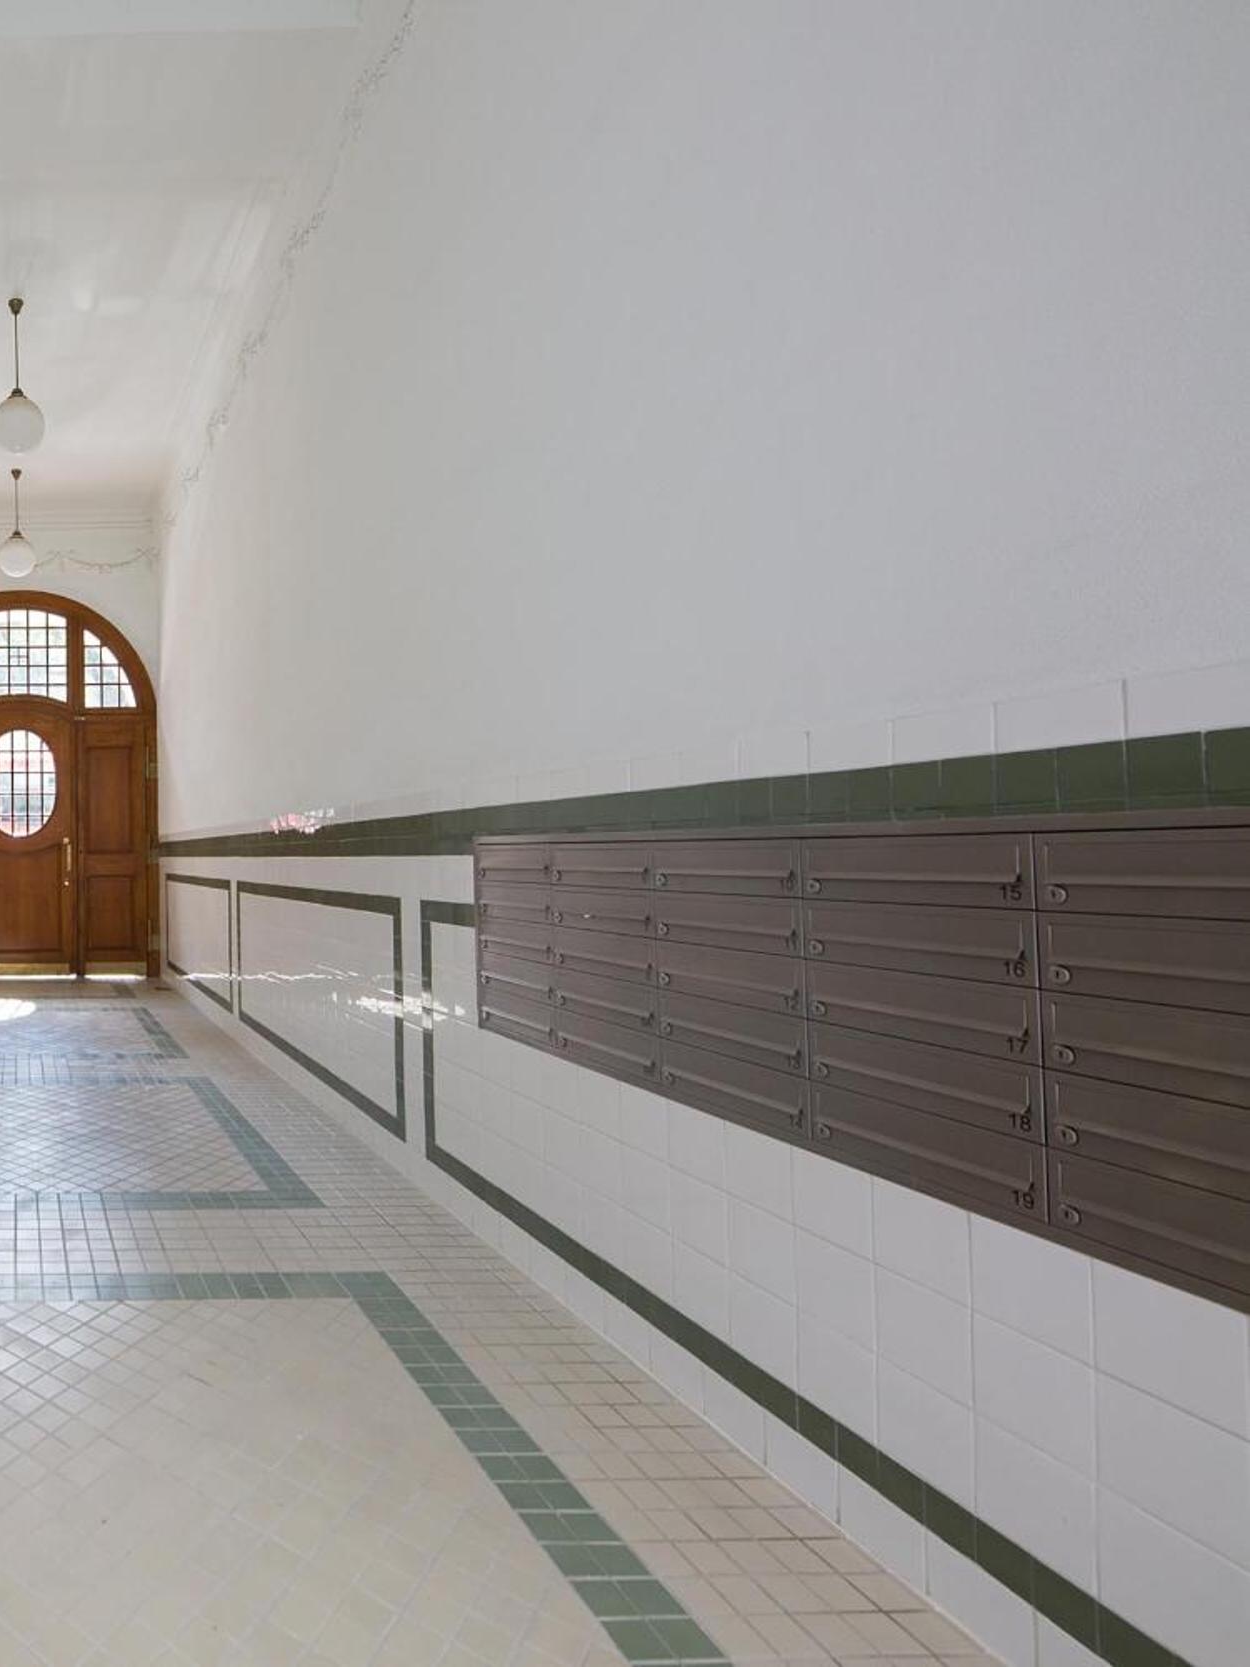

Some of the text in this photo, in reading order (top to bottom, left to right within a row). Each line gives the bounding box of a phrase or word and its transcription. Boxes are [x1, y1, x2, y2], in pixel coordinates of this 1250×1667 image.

[999, 884, 1022, 901] 15
[1003, 960, 1025, 978] 16
[1006, 1036, 1029, 1054] 17
[1008, 1113, 1031, 1132] 18
[1011, 1189, 1035, 1210] 19
